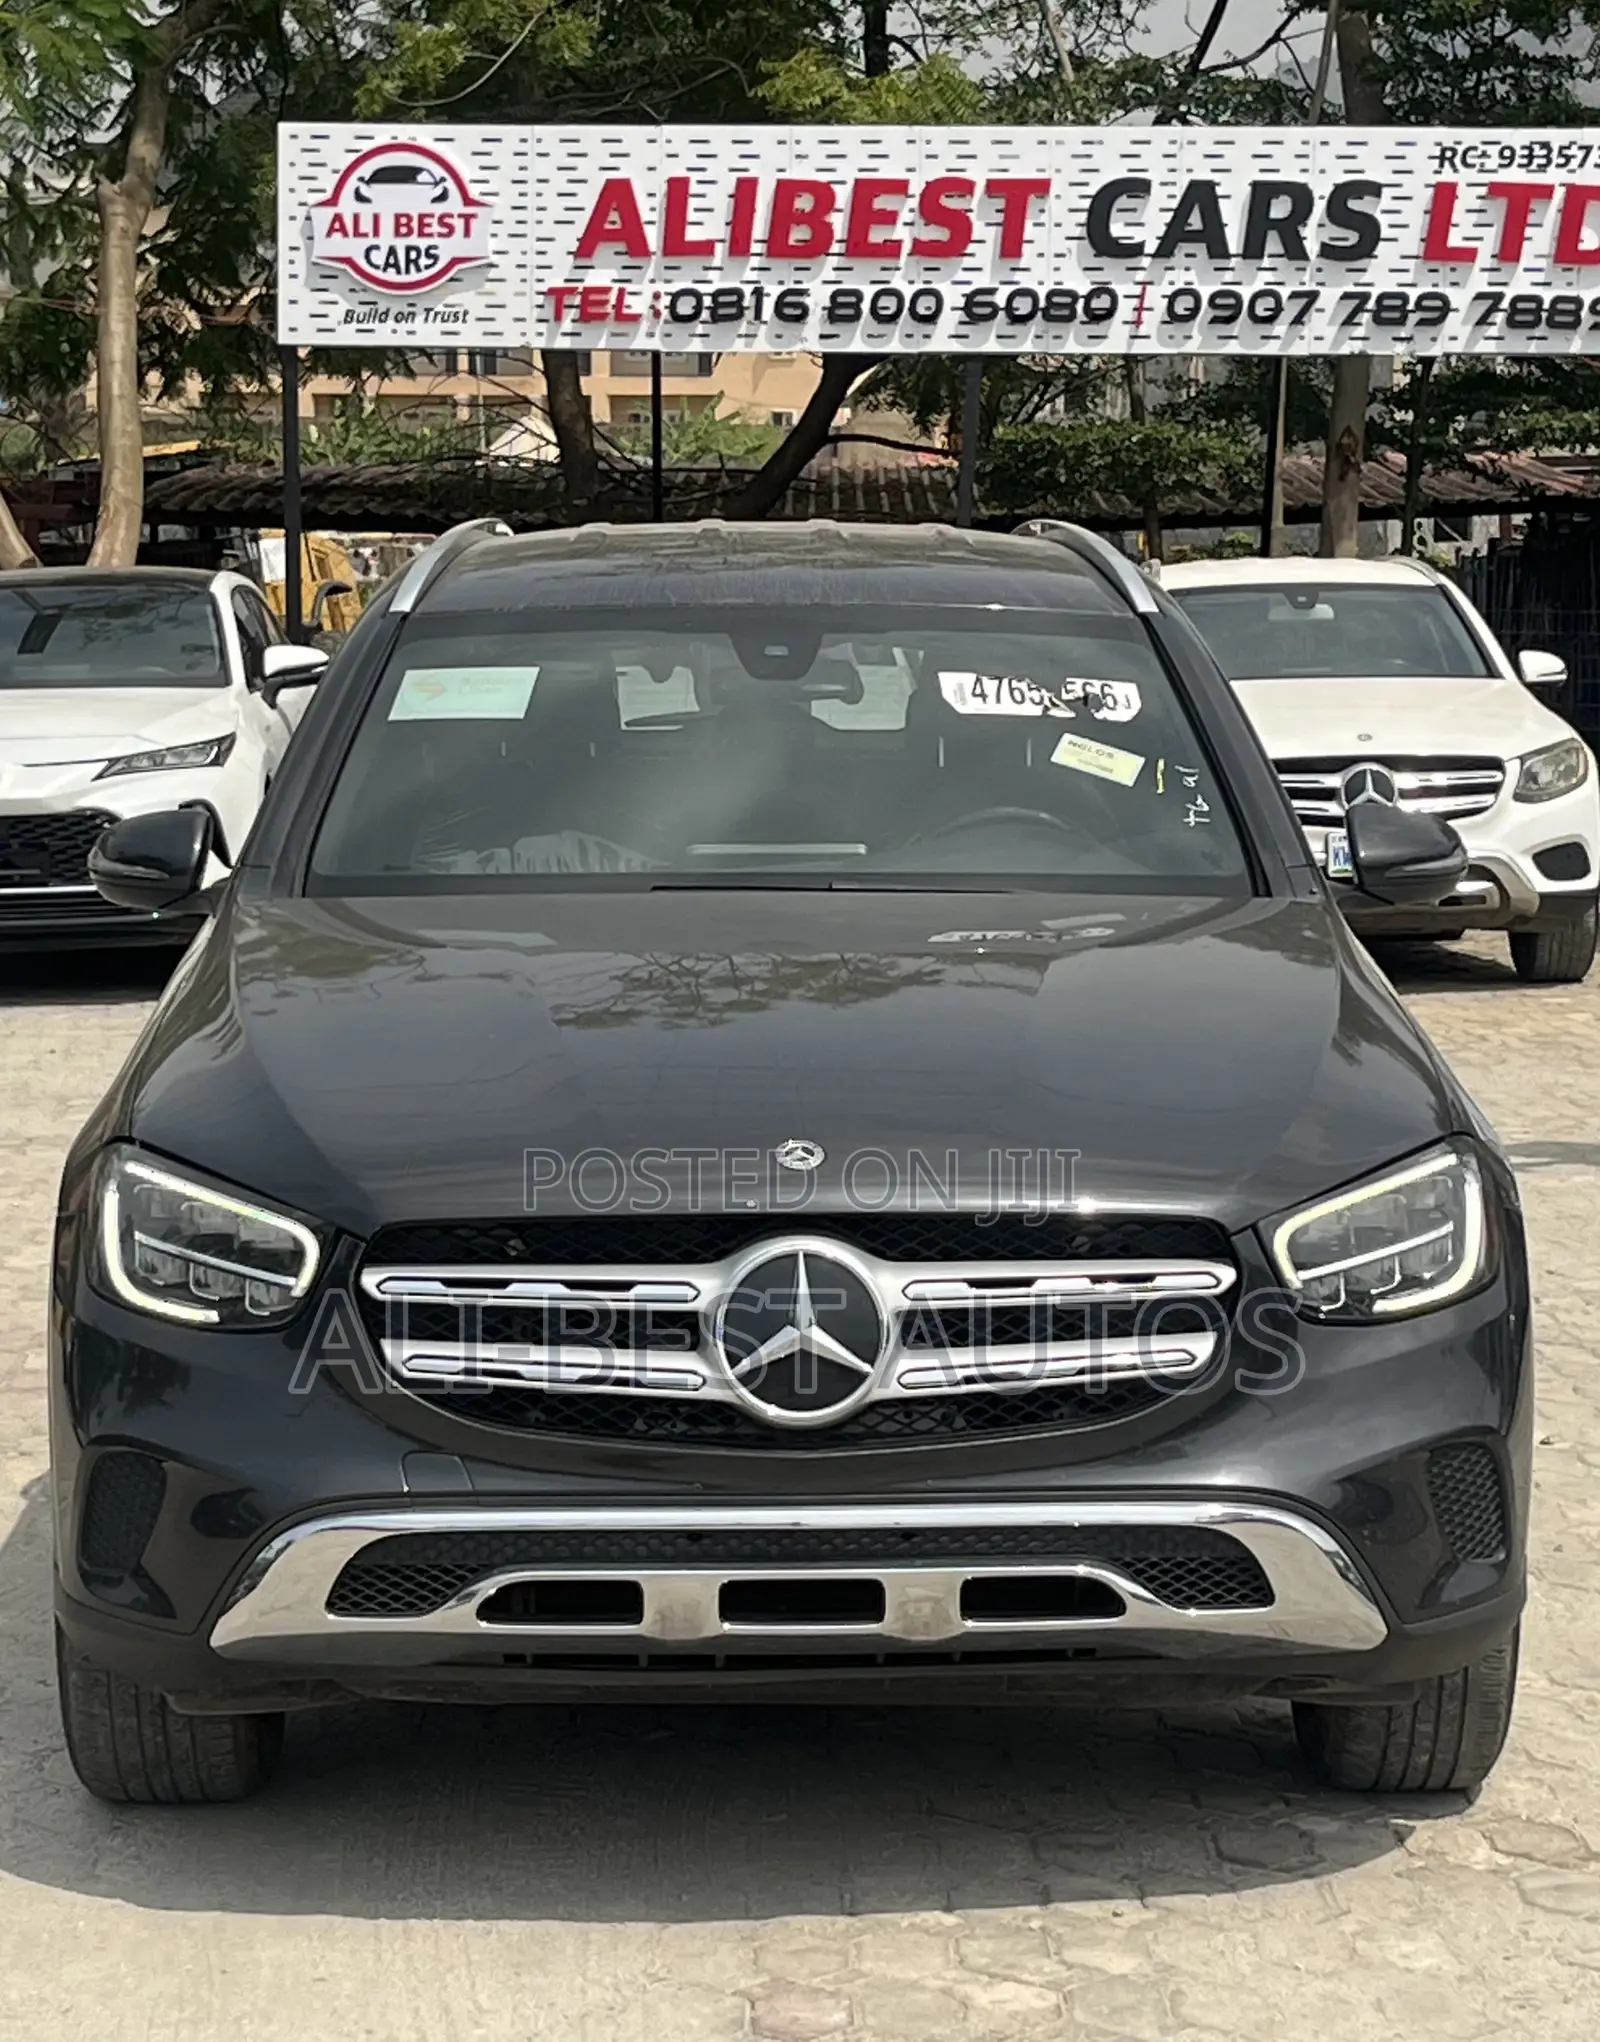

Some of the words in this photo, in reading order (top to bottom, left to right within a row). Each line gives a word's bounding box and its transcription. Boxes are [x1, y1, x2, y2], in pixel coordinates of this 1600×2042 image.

[325, 213, 382, 239] ALI
[394, 213, 478, 239] BEST
[575, 176, 1051, 260] ALIBEST
[1085, 176, 1382, 261] CARS
[1422, 181, 1600, 265] LTD
[364, 244, 440, 275] CARS
[343, 307, 391, 325] Build
[394, 311, 417, 324] on
[423, 307, 469, 325] Trust
[670, 287, 810, 323] 0816
[828, 287, 943, 324] 800
[963, 287, 1119, 324] 6080
[1166, 287, 1320, 326] 0907
[1341, 290, 1451, 328] 789
